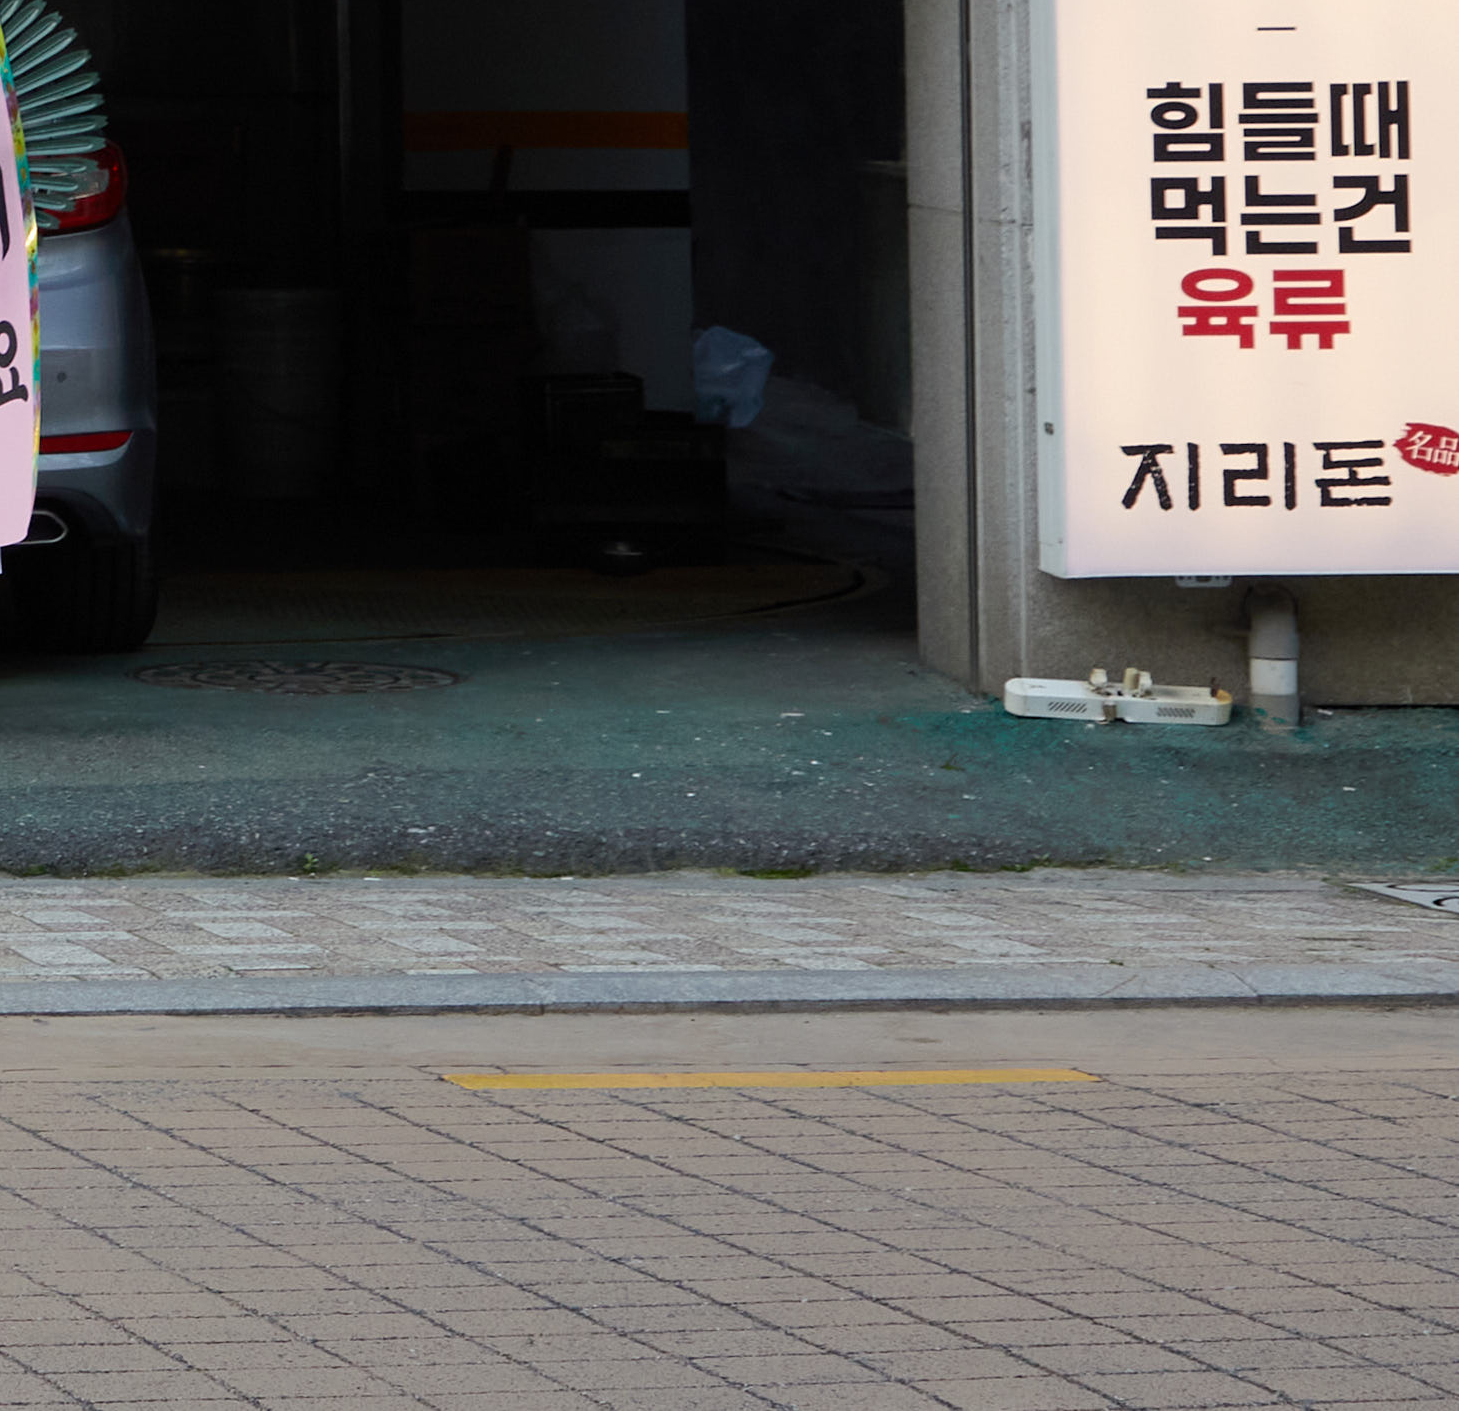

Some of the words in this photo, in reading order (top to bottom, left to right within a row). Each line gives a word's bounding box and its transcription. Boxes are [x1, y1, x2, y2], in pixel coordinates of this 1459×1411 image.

[1147, 80, 1410, 163] 힘들때
[1150, 174, 1411, 256] 먹는건
[1178, 268, 1351, 350] 육류
[1121, 440, 1392, 511] 지리돈
